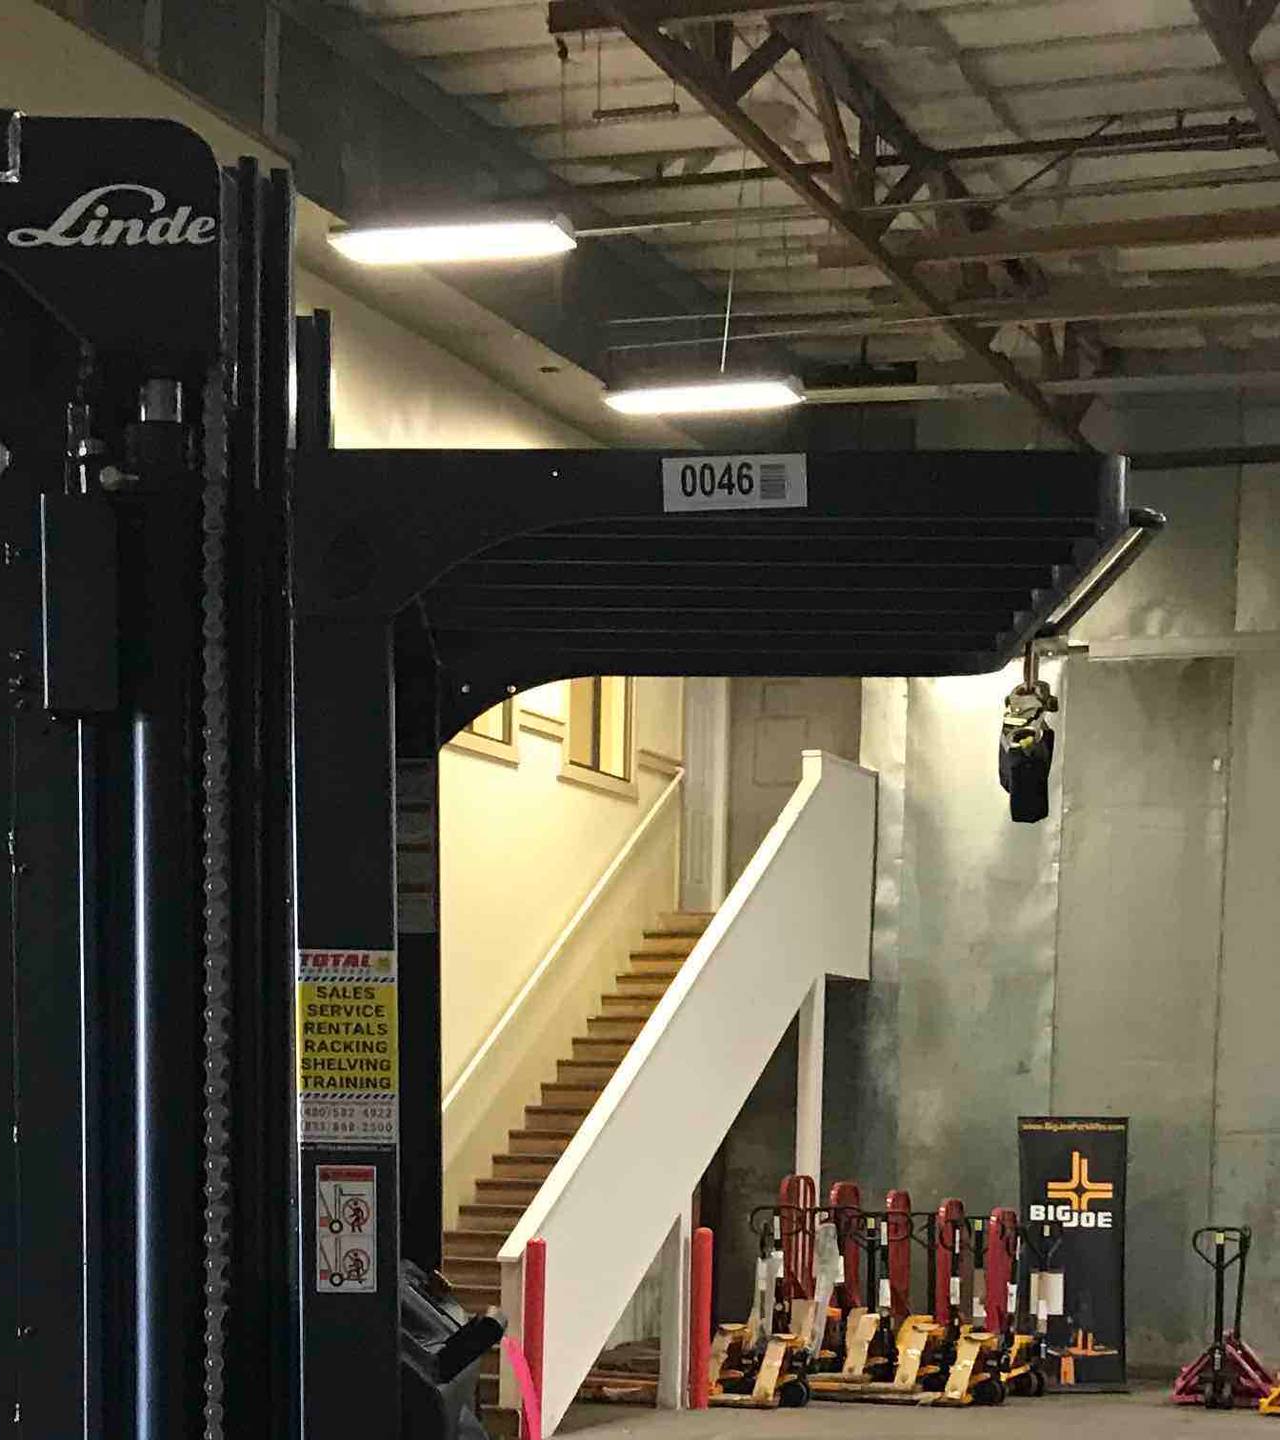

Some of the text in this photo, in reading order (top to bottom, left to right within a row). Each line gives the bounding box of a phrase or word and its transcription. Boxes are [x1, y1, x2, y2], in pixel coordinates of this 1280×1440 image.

[7, 184, 216, 246] Linde
[680, 461, 755, 498] 0046
[316, 986, 376, 1000] SALES
[307, 1003, 386, 1018] SERVICE
[303, 1021, 388, 1036] RENTALS
[304, 1039, 388, 1054] RACKING
[301, 1057, 392, 1072] SHELVING
[301, 1075, 392, 1090] TRAINING
[1029, 1204, 1113, 1228] BIG JOE
